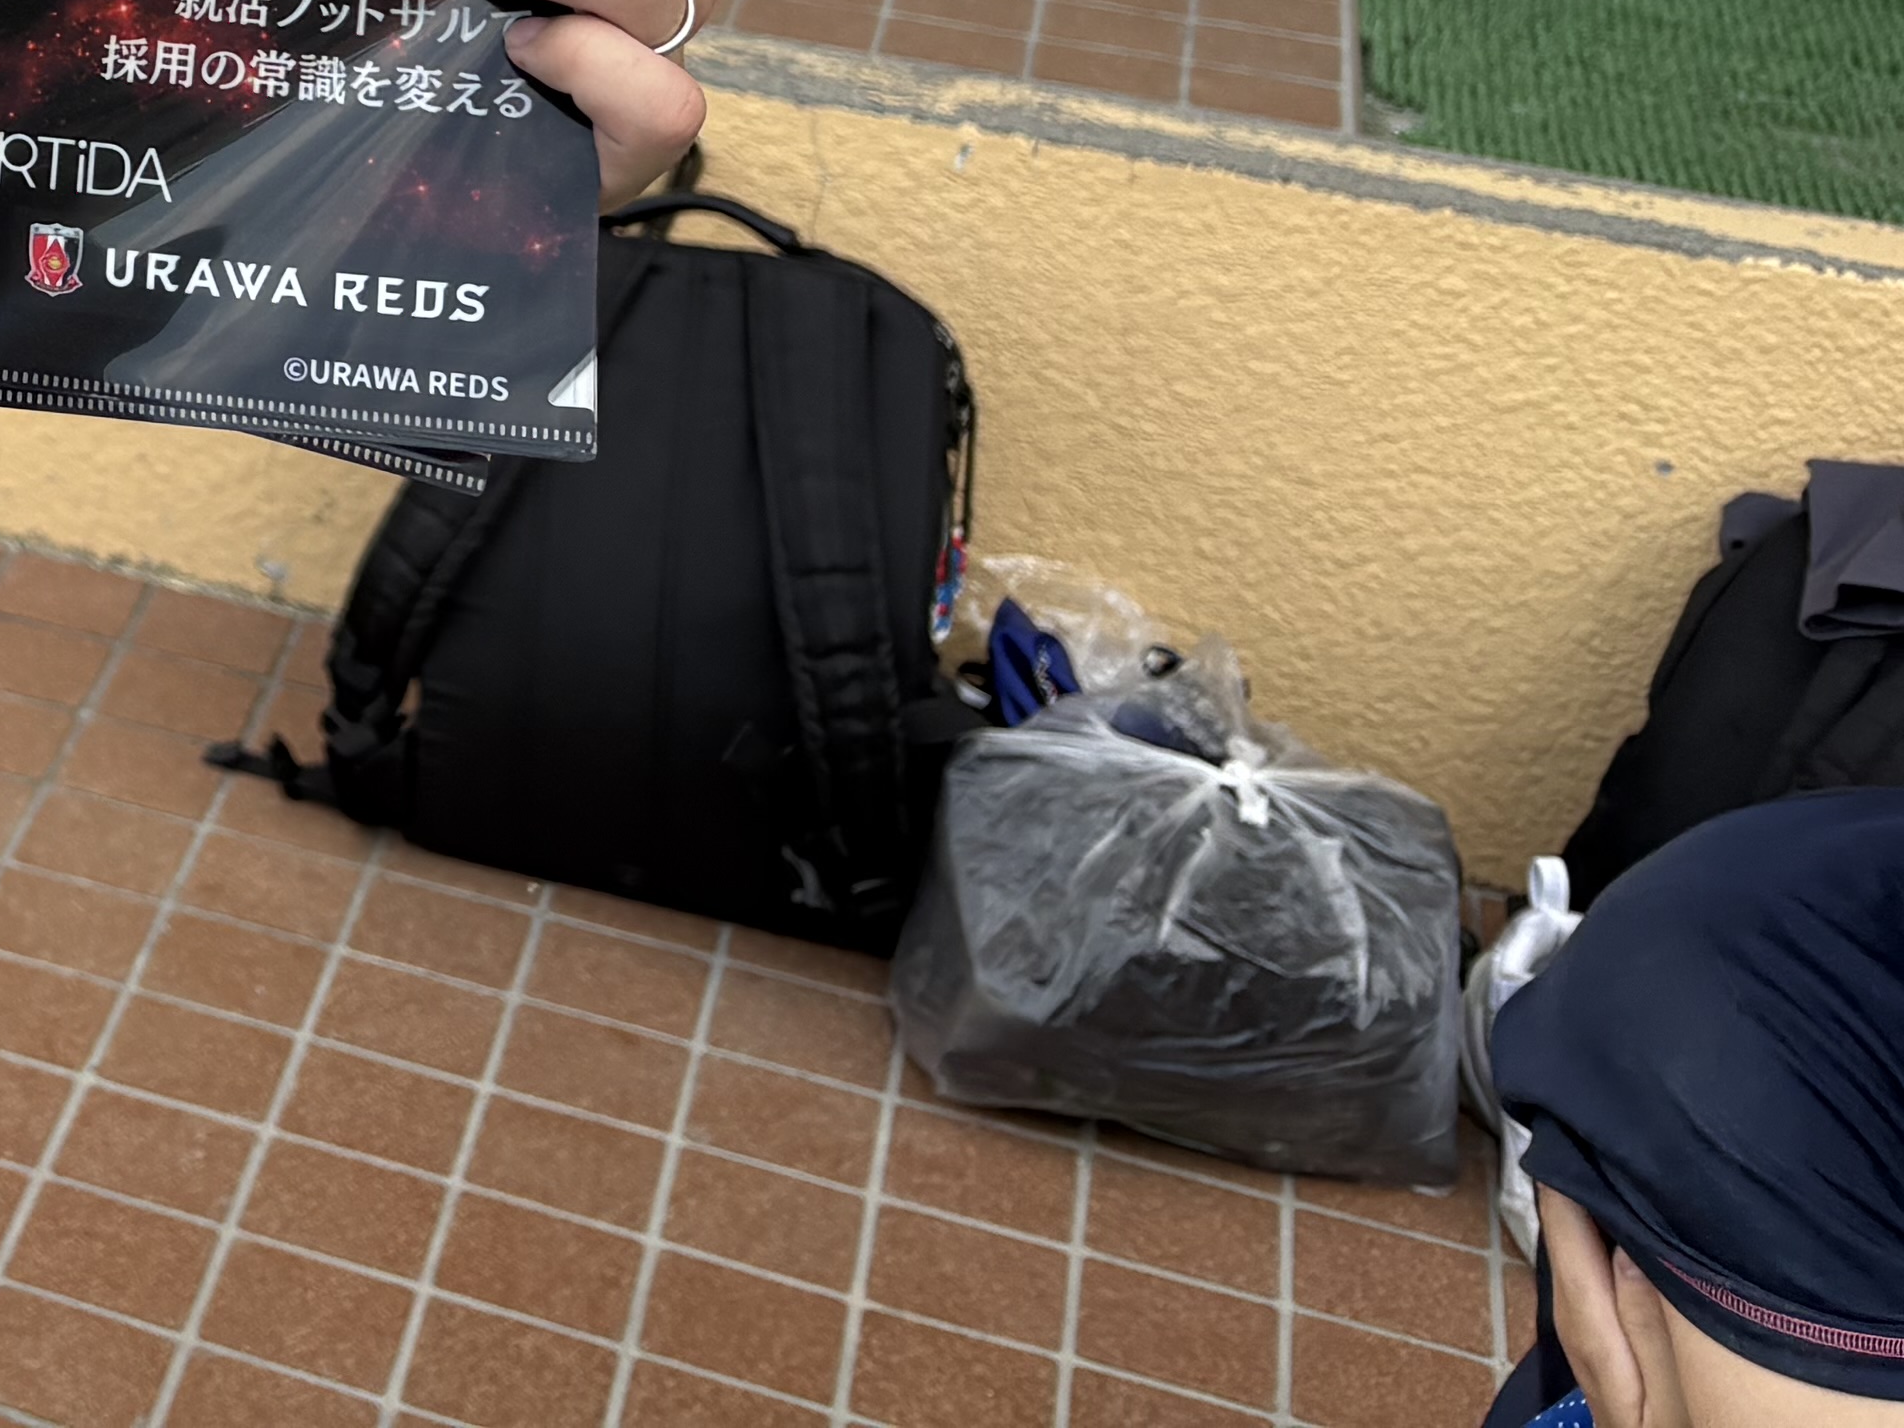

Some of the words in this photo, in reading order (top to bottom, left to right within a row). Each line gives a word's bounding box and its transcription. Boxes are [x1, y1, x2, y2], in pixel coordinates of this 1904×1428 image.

[99, 34, 534, 119] 採用の常識を変える
[104, 247, 308, 308] URAWA
[333, 272, 491, 323] REDS
[282, 355, 420, 395] ©URAWA
[428, 371, 510, 402] REDS
